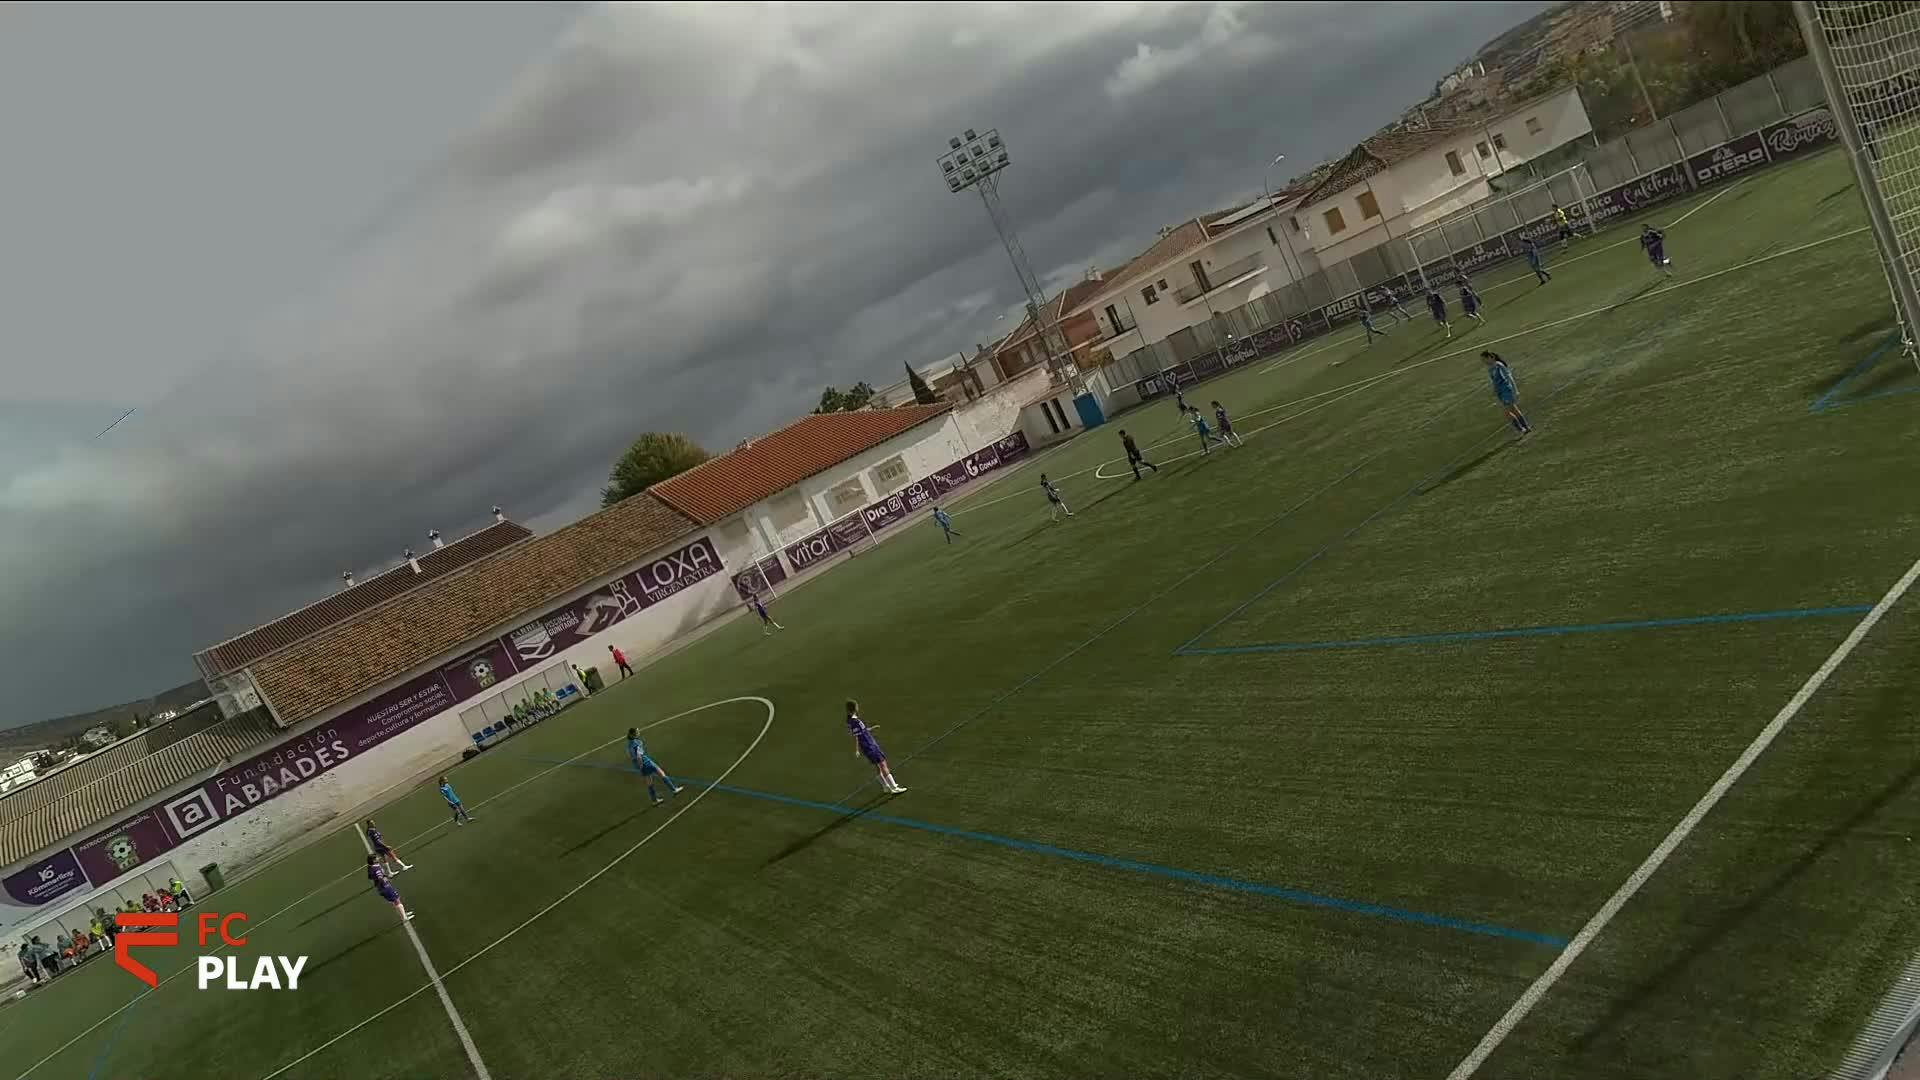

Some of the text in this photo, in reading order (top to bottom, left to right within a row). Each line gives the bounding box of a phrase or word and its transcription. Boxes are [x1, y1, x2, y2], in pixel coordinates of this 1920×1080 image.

[1697, 148, 1764, 180] OTERO
[1571, 195, 1612, 217] Clnica
[788, 534, 830, 566] vitar
[635, 543, 711, 594] LOXA
[647, 578, 685, 602] VIRGEN
[683, 565, 717, 585] EXTRA
[367, 703, 399, 724] NUESTRO
[399, 696, 413, 709] SER
[381, 702, 424, 726] Compromiso
